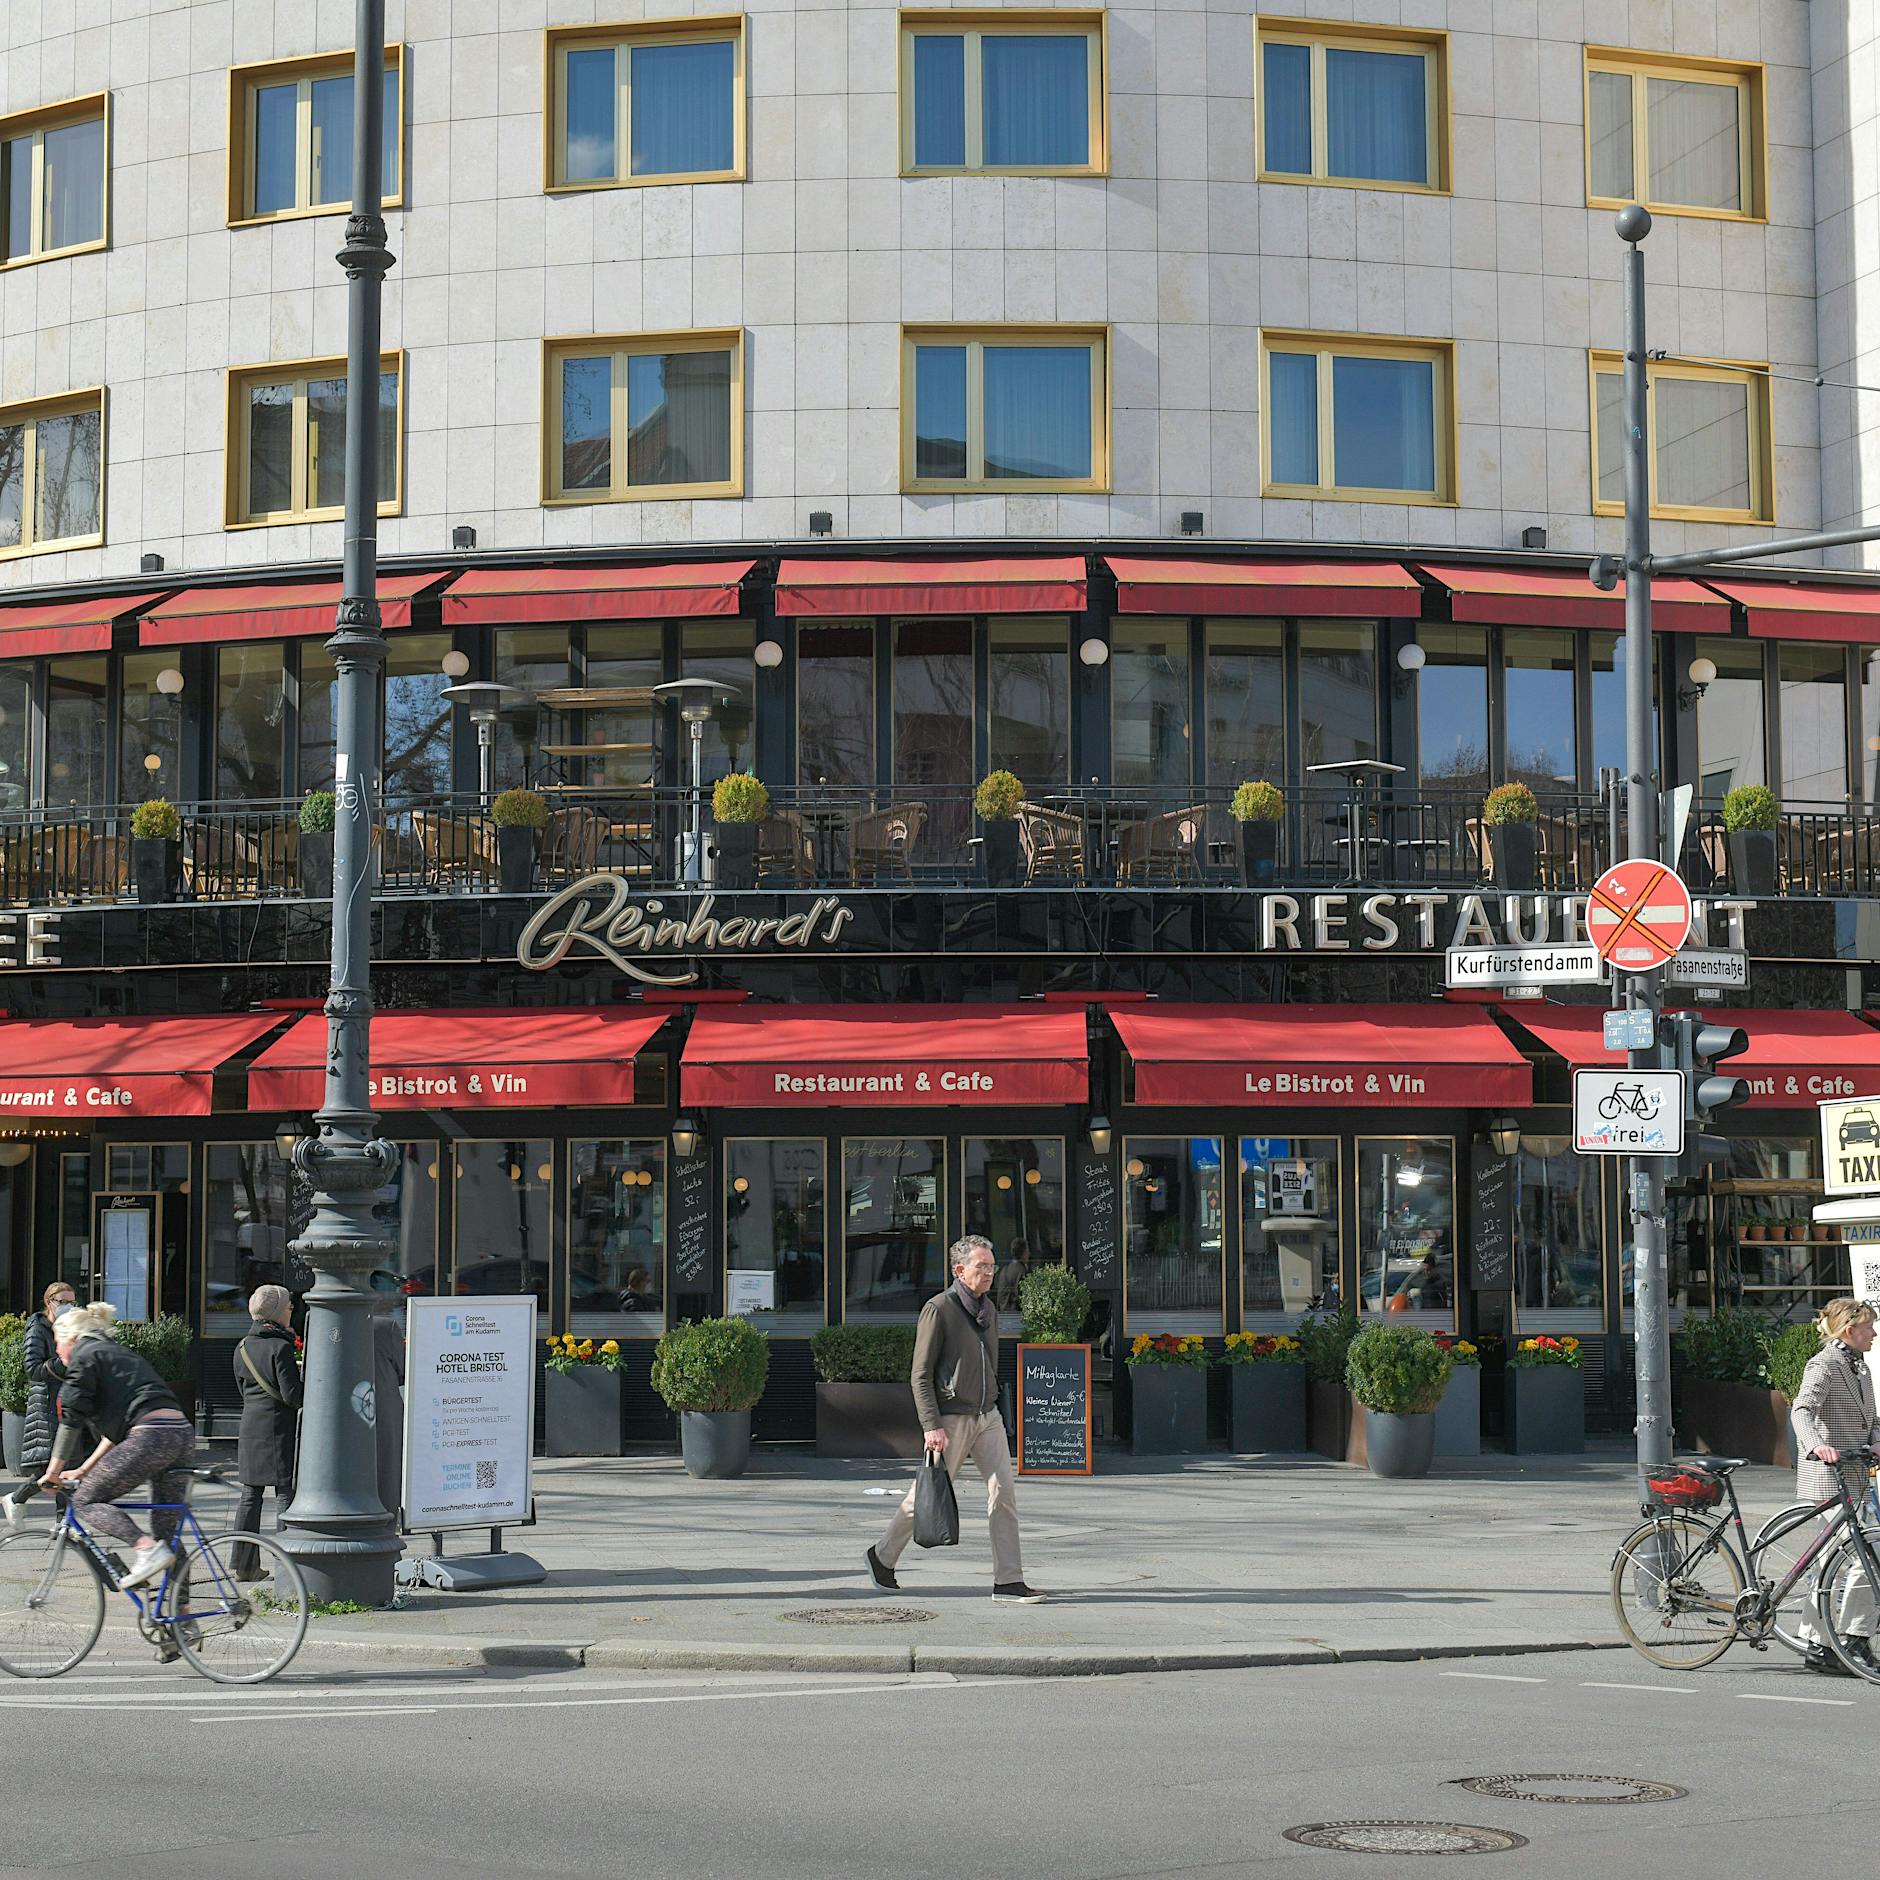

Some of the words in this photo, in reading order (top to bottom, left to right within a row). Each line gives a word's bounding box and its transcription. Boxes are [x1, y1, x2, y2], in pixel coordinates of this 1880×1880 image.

[517, 873, 853, 985] Reinhard's
[1456, 952, 1594, 974] Kurfürstendamm
[381, 1076, 456, 1095] Bistrot
[467, 1074, 482, 1093] &
[490, 1073, 526, 1093] Vin
[774, 1074, 903, 1092] Restaurant
[915, 1072, 930, 1091] &
[940, 1072, 994, 1091] Cafe
[1246, 1073, 1271, 1092] Le
[1275, 1074, 1353, 1093] Bistrot
[1365, 1074, 1380, 1093] &
[1388, 1074, 1425, 1093] Vin
[1785, 1076, 1799, 1094] &
[1807, 1075, 1854, 1094] Cafe
[64, 1087, 78, 1106] &
[86, 1087, 133, 1105] Cafe
[439, 1353, 482, 1363] CORONA
[483, 1352, 505, 1362] TEST
[436, 1364, 468, 1374] HOTEL
[470, 1362, 508, 1372] BRISTOL
[442, 1396, 482, 1405] BÜRGERTEST
[1026, 1396, 1048, 1406] Kleines
[442, 1463, 471, 1472] TERMINE
[446, 1473, 471, 1481] ONLINE
